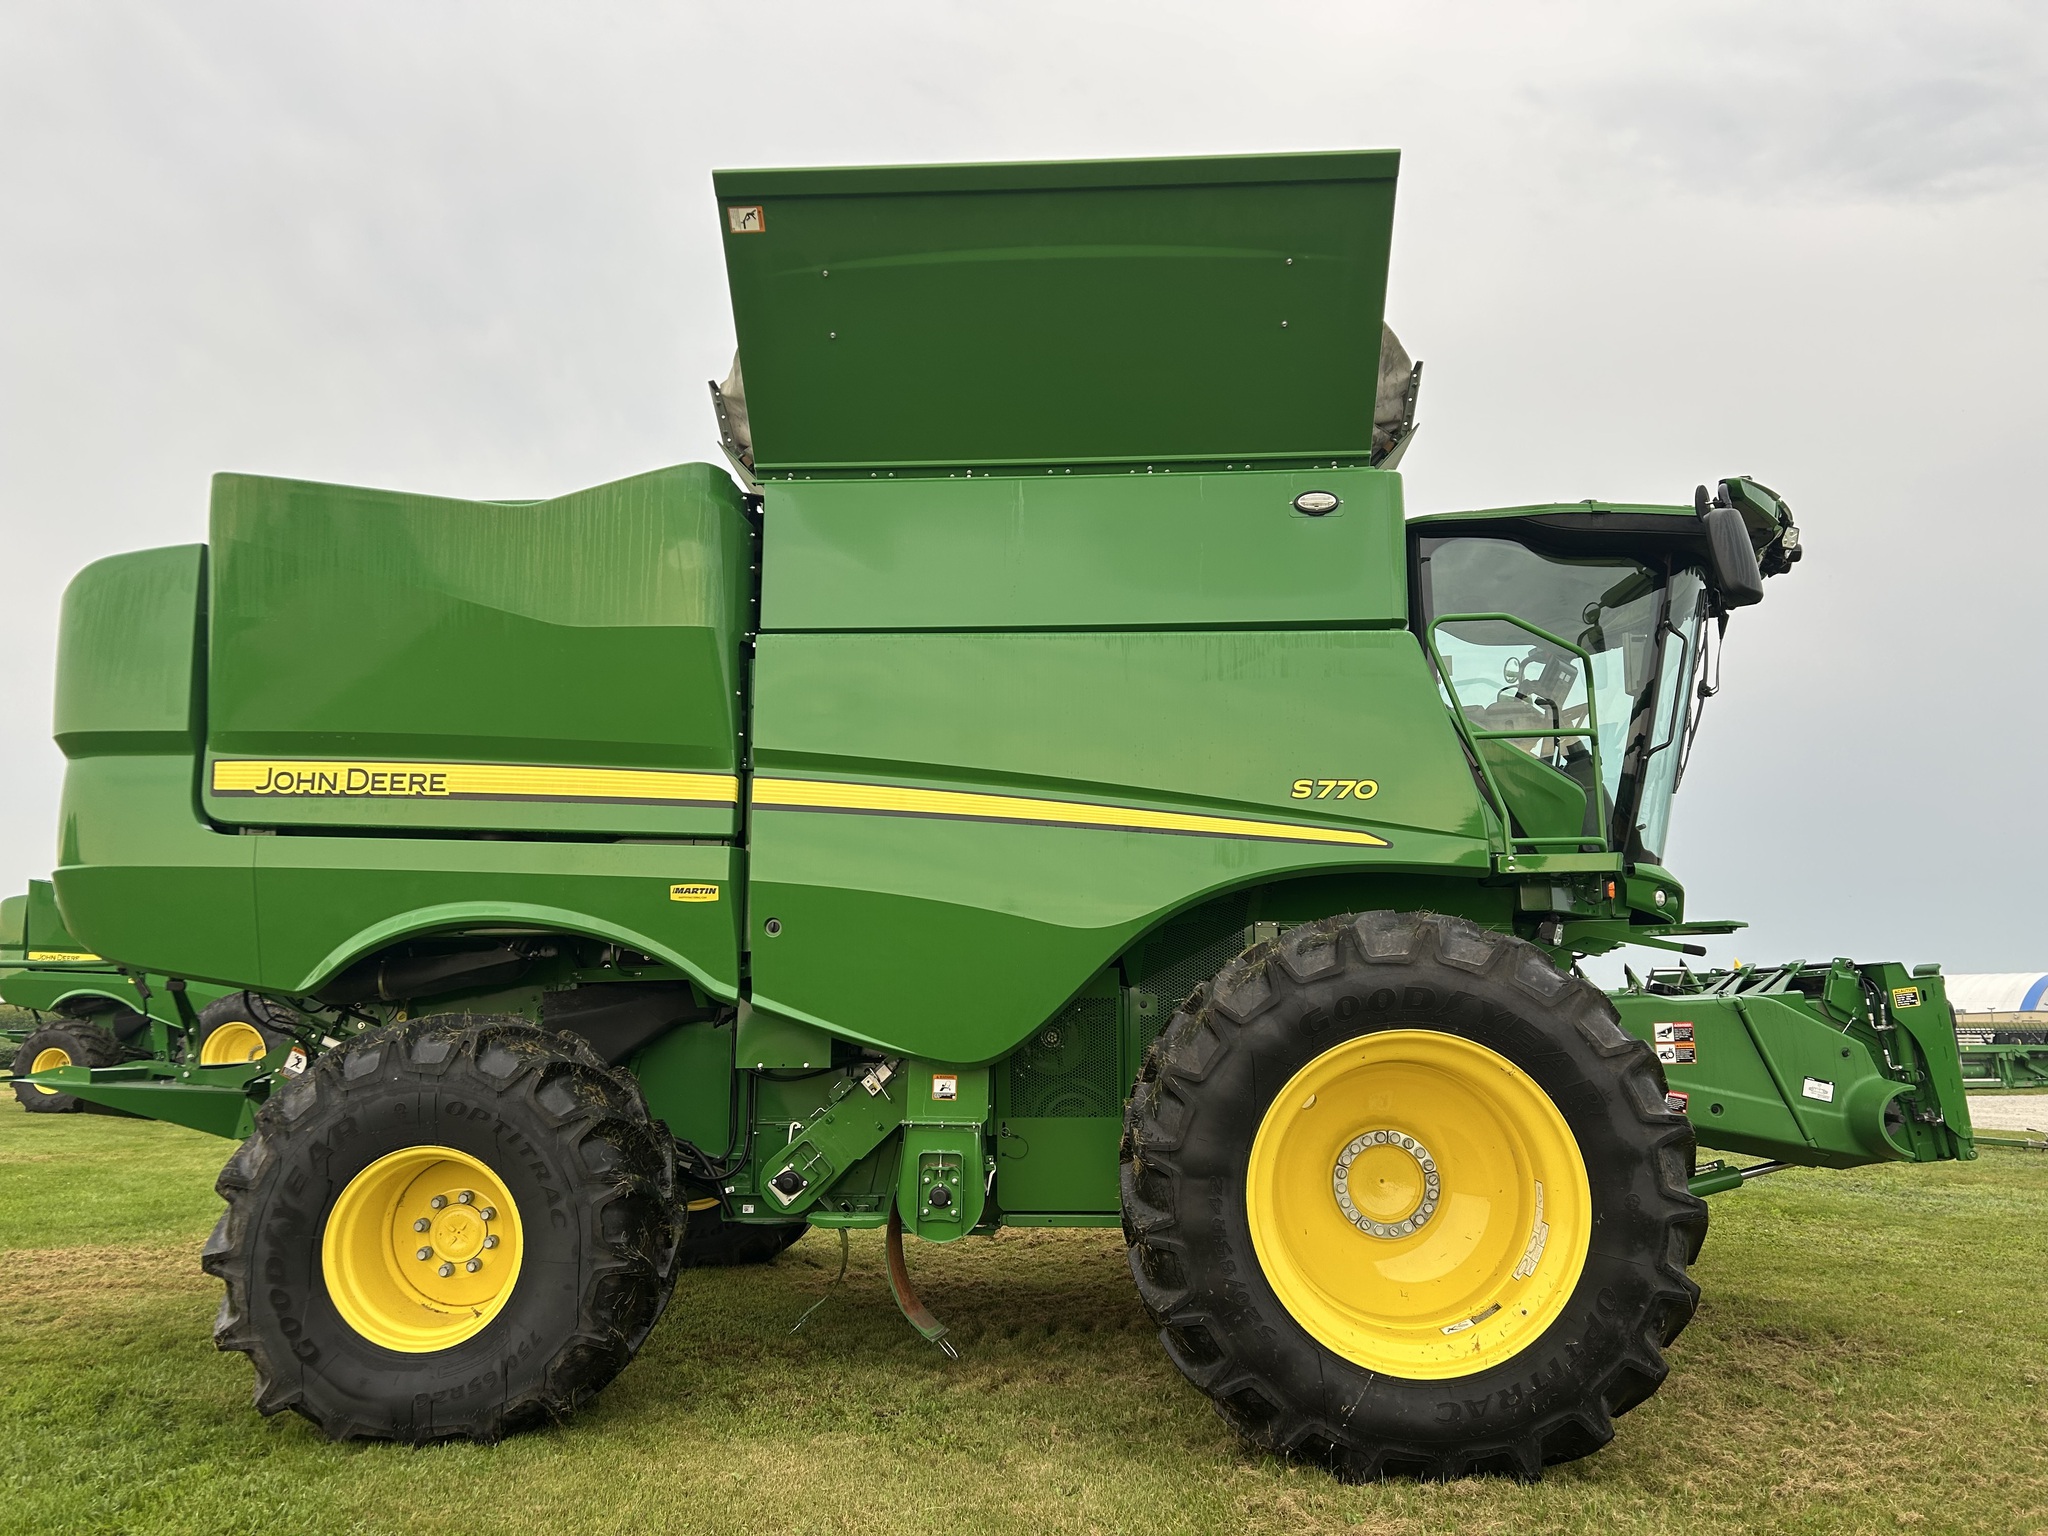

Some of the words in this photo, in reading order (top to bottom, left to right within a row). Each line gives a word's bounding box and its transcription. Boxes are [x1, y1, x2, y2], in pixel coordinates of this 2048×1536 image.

[255, 767, 338, 791] JOHN
[346, 768, 447, 792] DEERE
[1290, 778, 1379, 800] S770
[673, 887, 717, 895] MARTIN
[1299, 985, 1608, 1117] GOODYEAR
[445, 1101, 567, 1230] OPTITRAC
[265, 1116, 361, 1366] GOODYEAR
[1433, 1287, 1617, 1425] OPTITRAC
